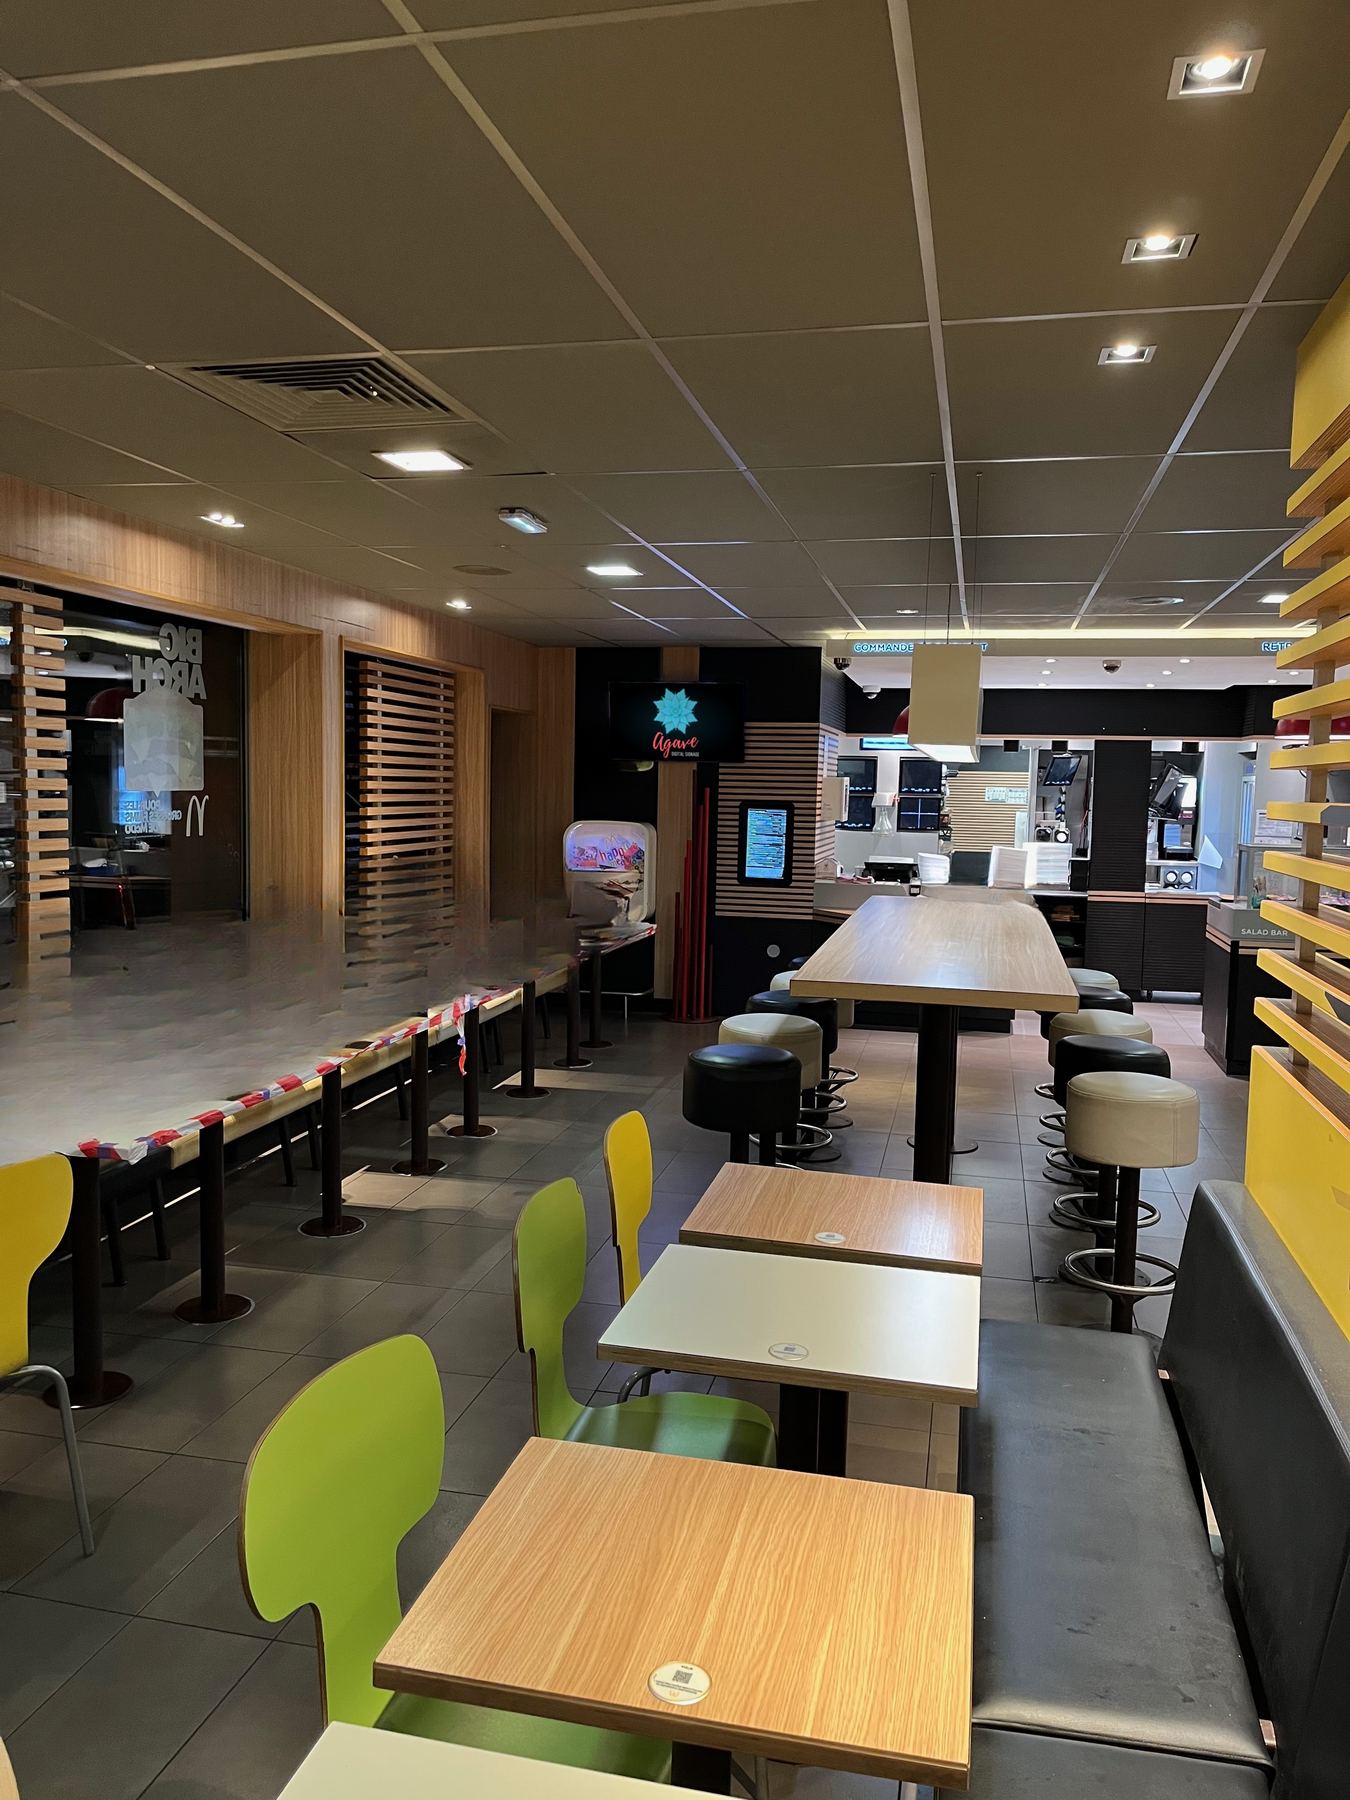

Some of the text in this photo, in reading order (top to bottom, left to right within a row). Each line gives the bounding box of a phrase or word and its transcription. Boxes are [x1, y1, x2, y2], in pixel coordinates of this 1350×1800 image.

[854, 642, 914, 653] COMMANDE
[652, 731, 699, 759] Agave
[1240, 928, 1288, 937] SALAD BAR
